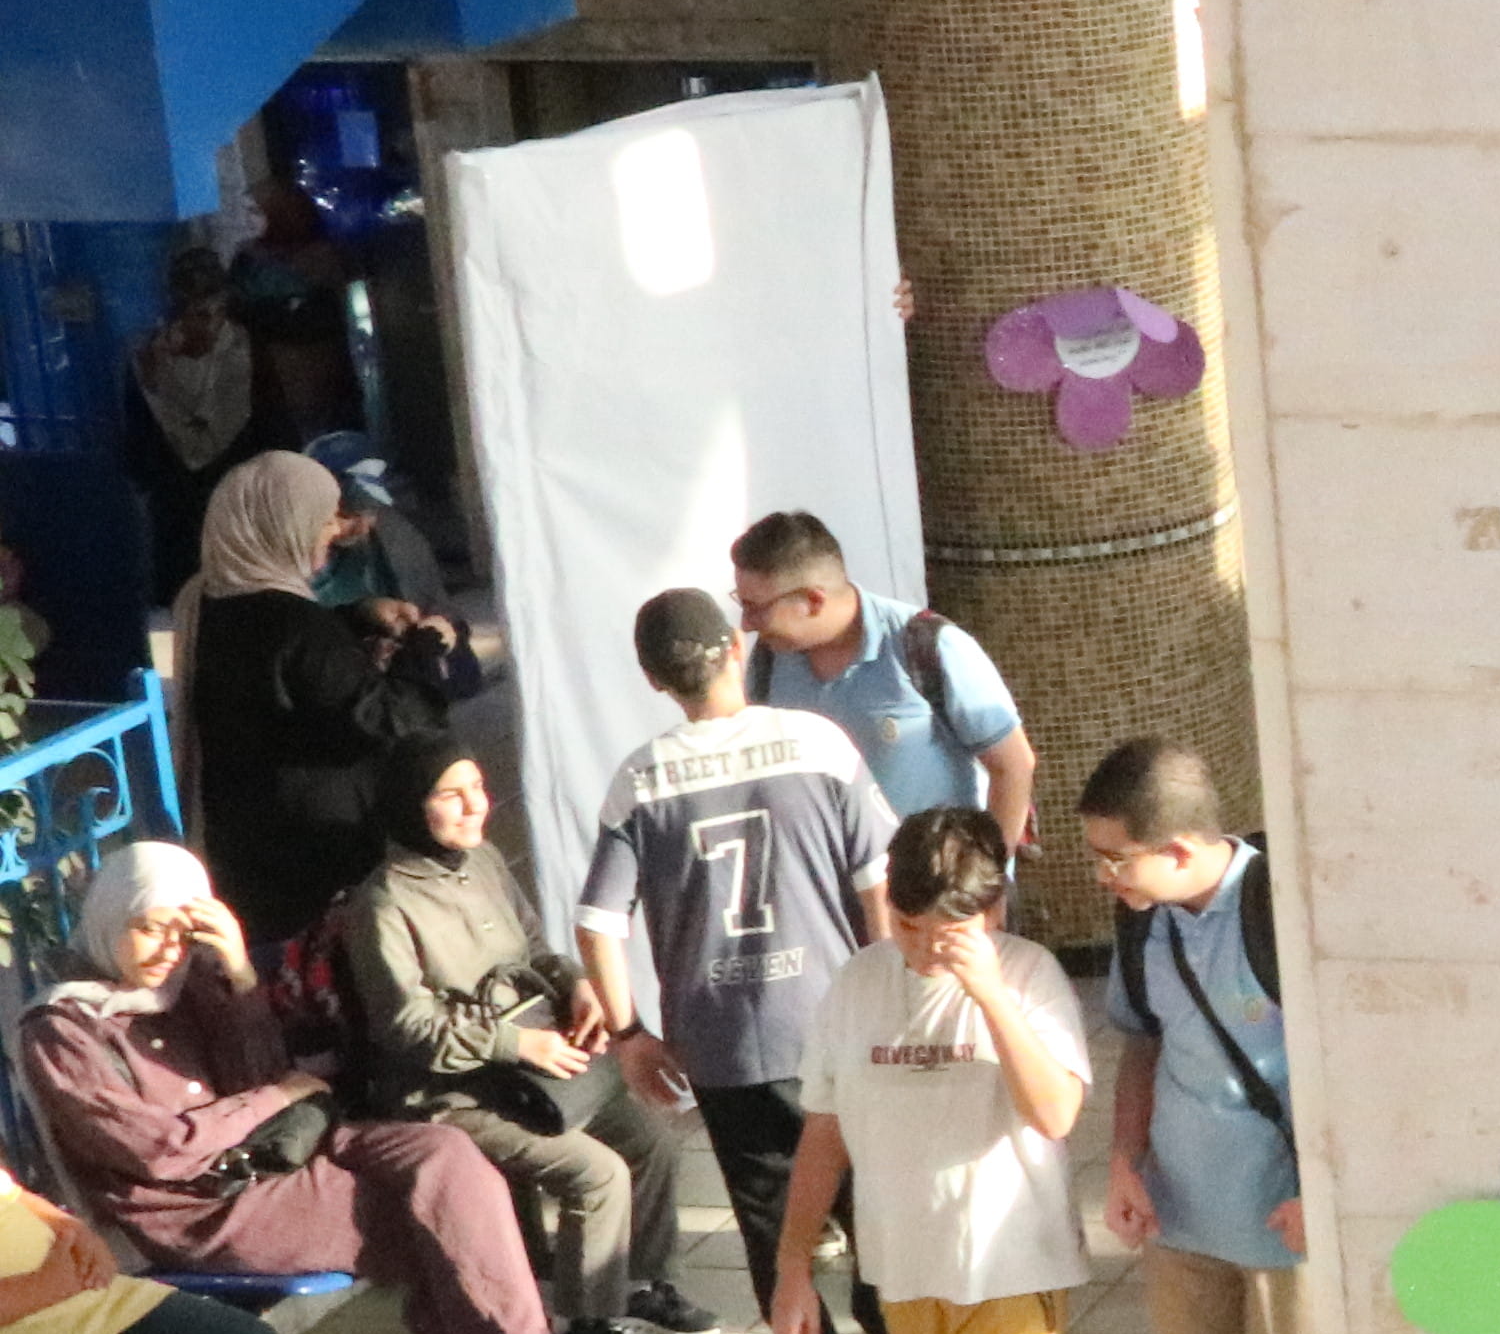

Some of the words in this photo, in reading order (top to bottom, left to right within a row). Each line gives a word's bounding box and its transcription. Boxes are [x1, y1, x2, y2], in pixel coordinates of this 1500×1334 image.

[739, 738, 803, 772] TIDE
[690, 808, 776, 937] 7
[708, 946, 806, 985] SEVEN
